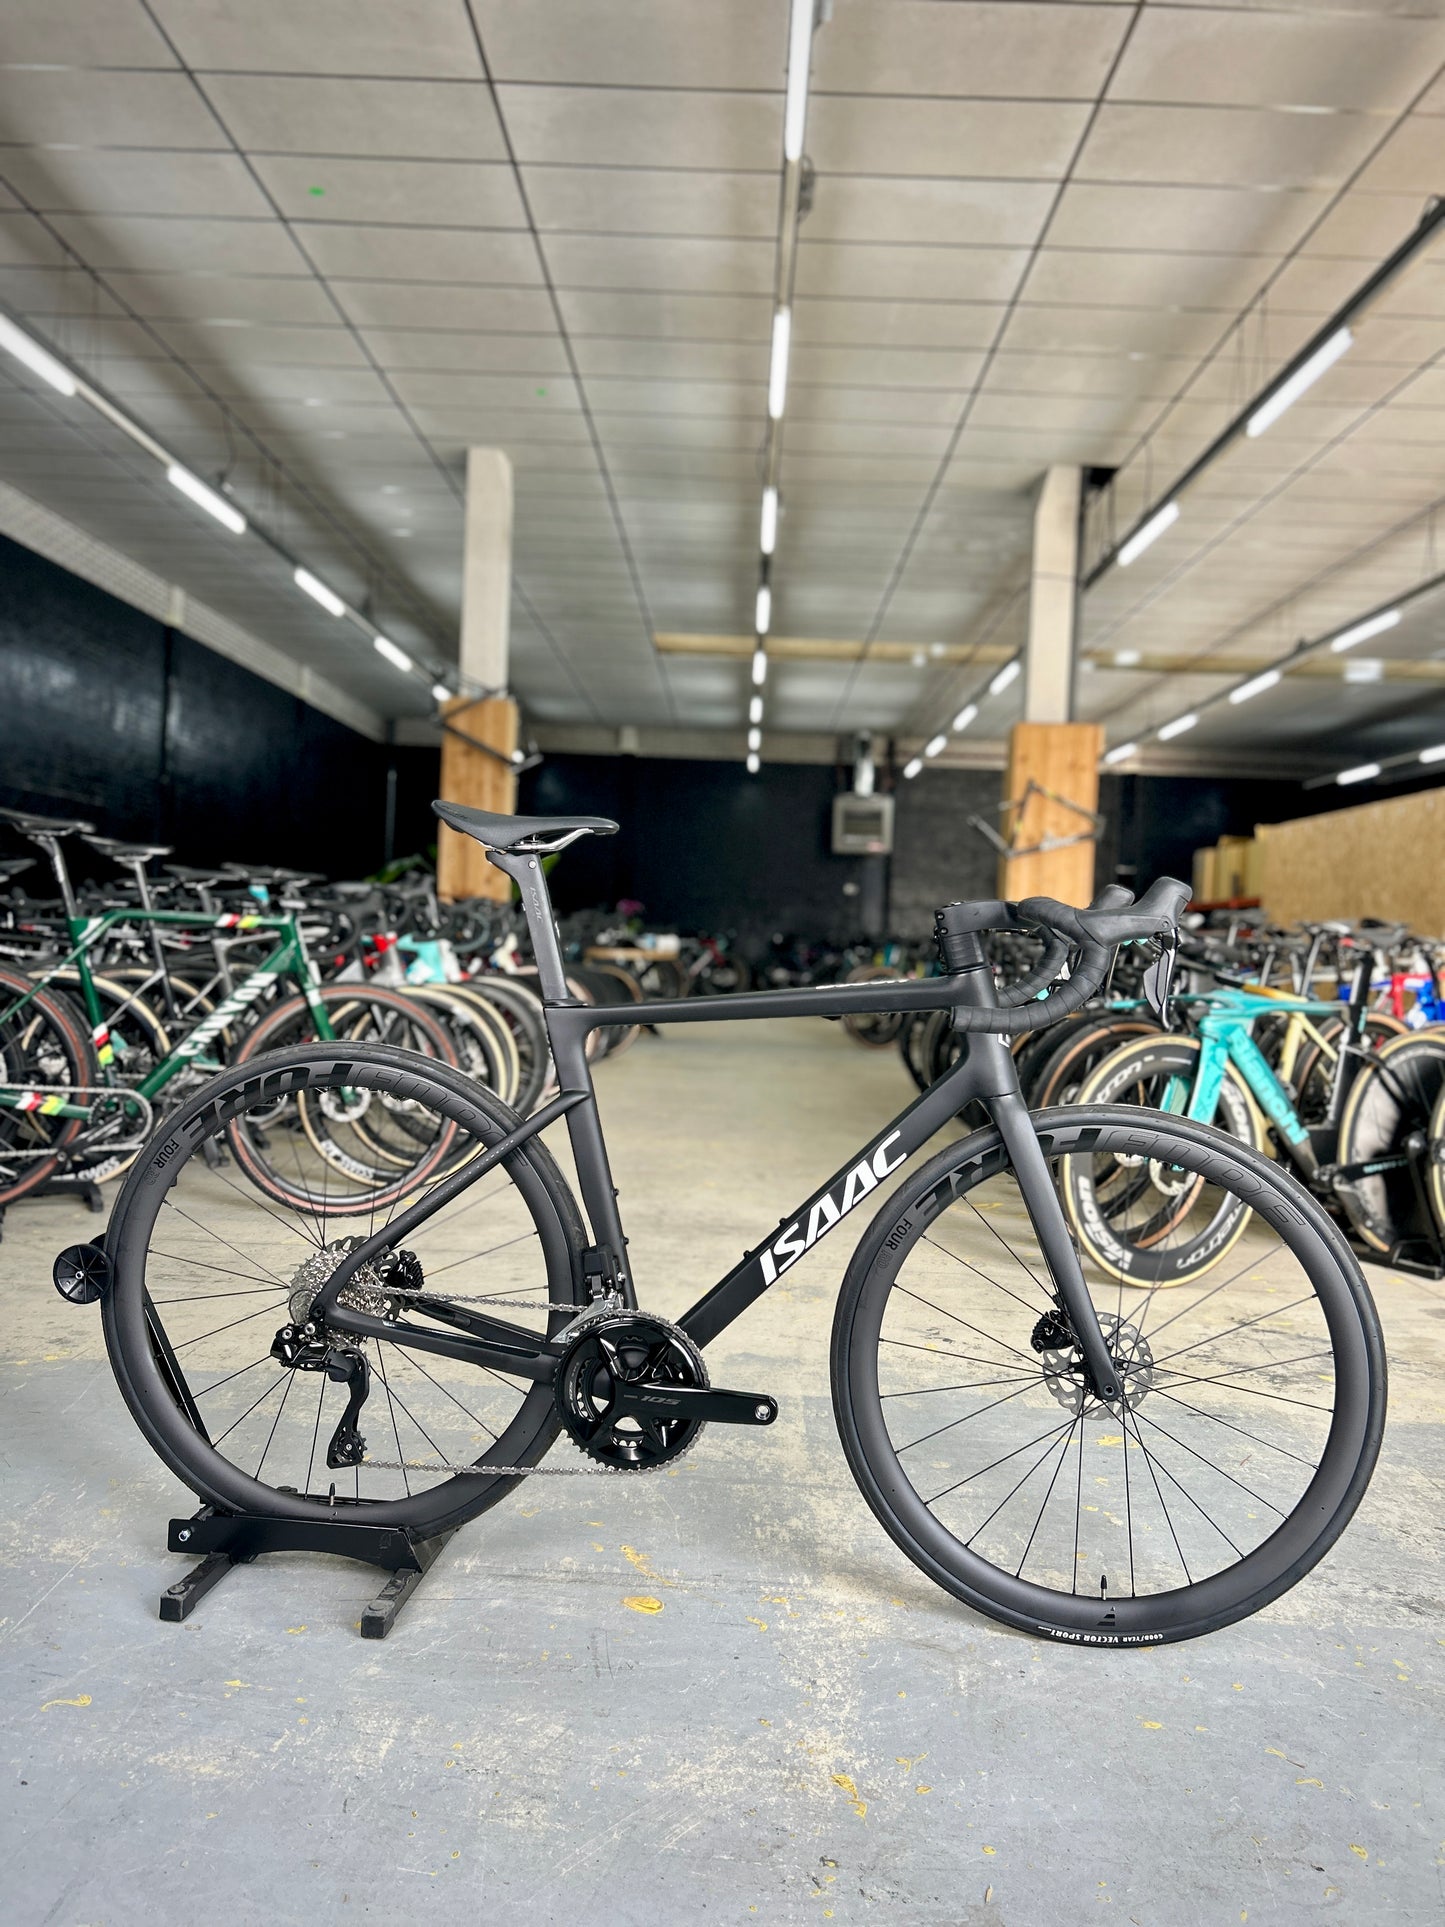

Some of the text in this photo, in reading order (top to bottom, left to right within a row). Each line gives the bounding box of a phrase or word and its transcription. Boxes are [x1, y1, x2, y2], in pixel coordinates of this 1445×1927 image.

[530, 886, 543, 923] ISAAC
[177, 971, 279, 1057] CANYON
[153, 1138, 179, 1168] FOUR
[760, 1130, 907, 1286] ISAAC
[885, 1218, 913, 1250] FOUR
[641, 1395, 681, 1405] 105
[1050, 1629, 1164, 1644] GOODYEAR VECTOR SPORT
